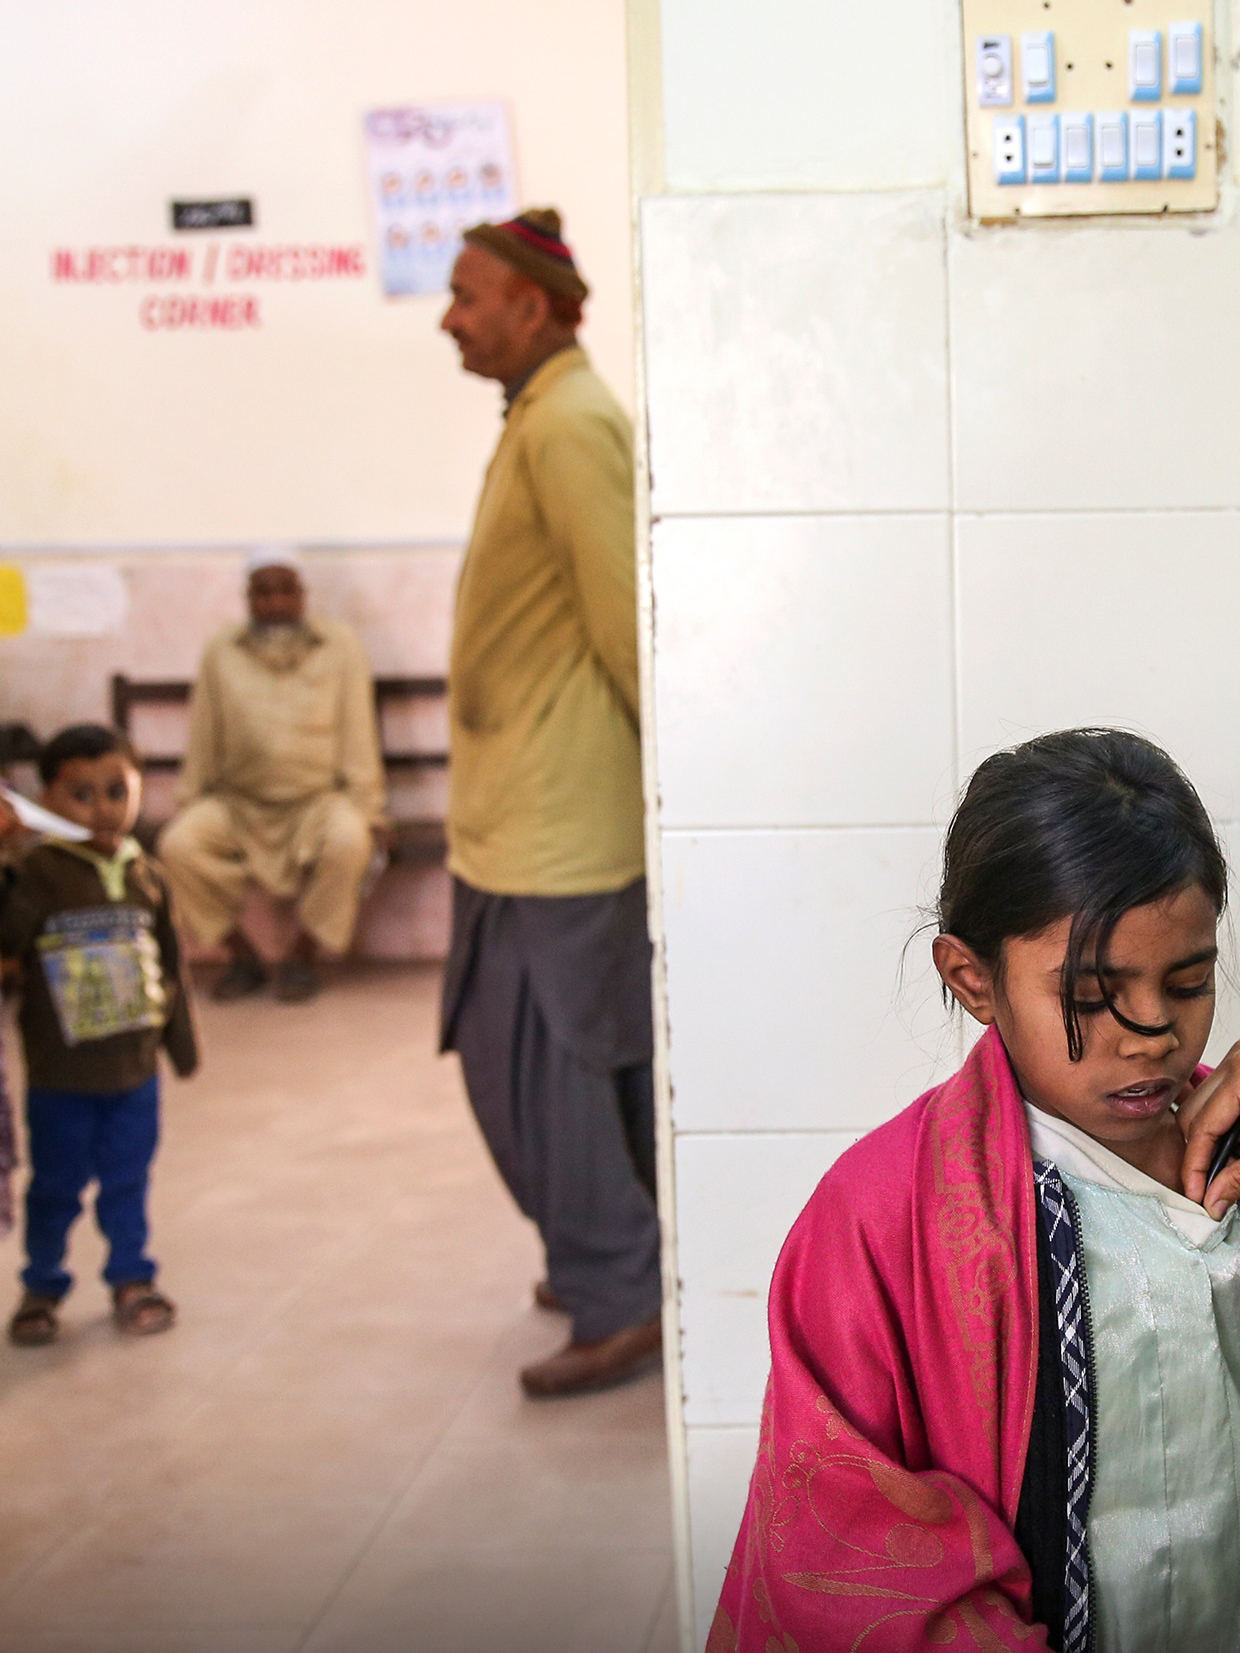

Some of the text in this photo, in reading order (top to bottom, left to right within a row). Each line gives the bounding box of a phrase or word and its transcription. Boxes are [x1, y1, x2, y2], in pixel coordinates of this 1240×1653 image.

[51, 243, 365, 284] INJECTION / DRESSING
[141, 296, 260, 329] CORNER
